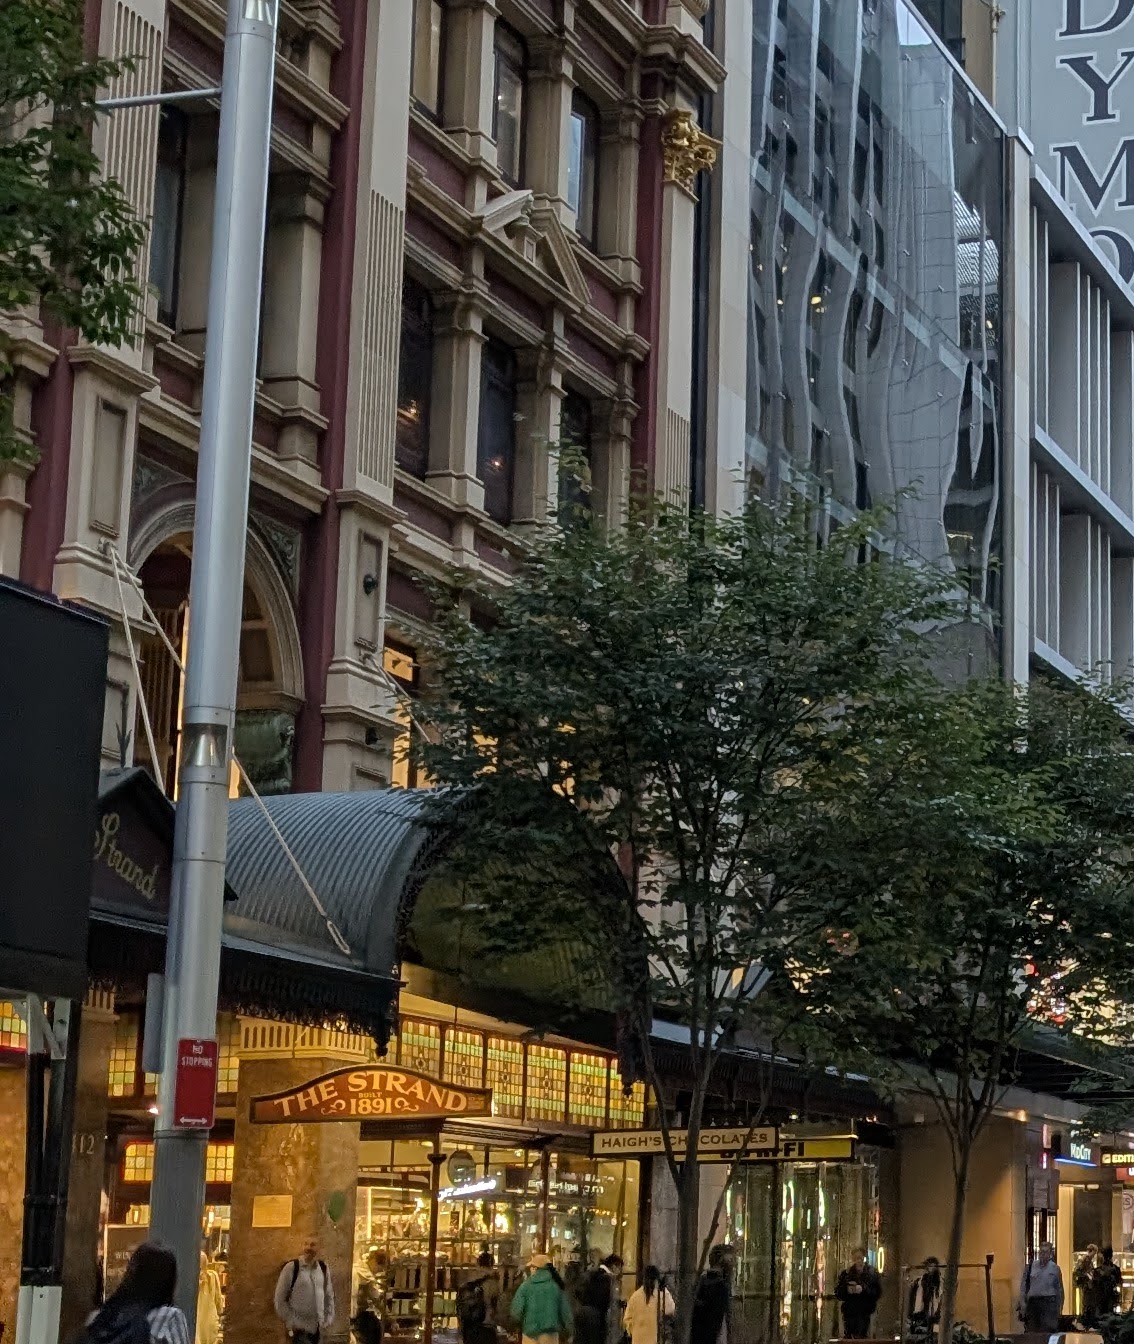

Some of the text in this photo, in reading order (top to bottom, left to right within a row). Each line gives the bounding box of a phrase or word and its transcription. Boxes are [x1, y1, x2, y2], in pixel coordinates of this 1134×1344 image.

[94, 812, 160, 900] Strand
[193, 1045, 203, 1054] NO
[181, 1056, 212, 1067] STOPPING
[274, 1070, 468, 1117] THE STRAND
[350, 1098, 392, 1115] 1891
[601, 1133, 768, 1149] HAIGH'S CHCOLATES
